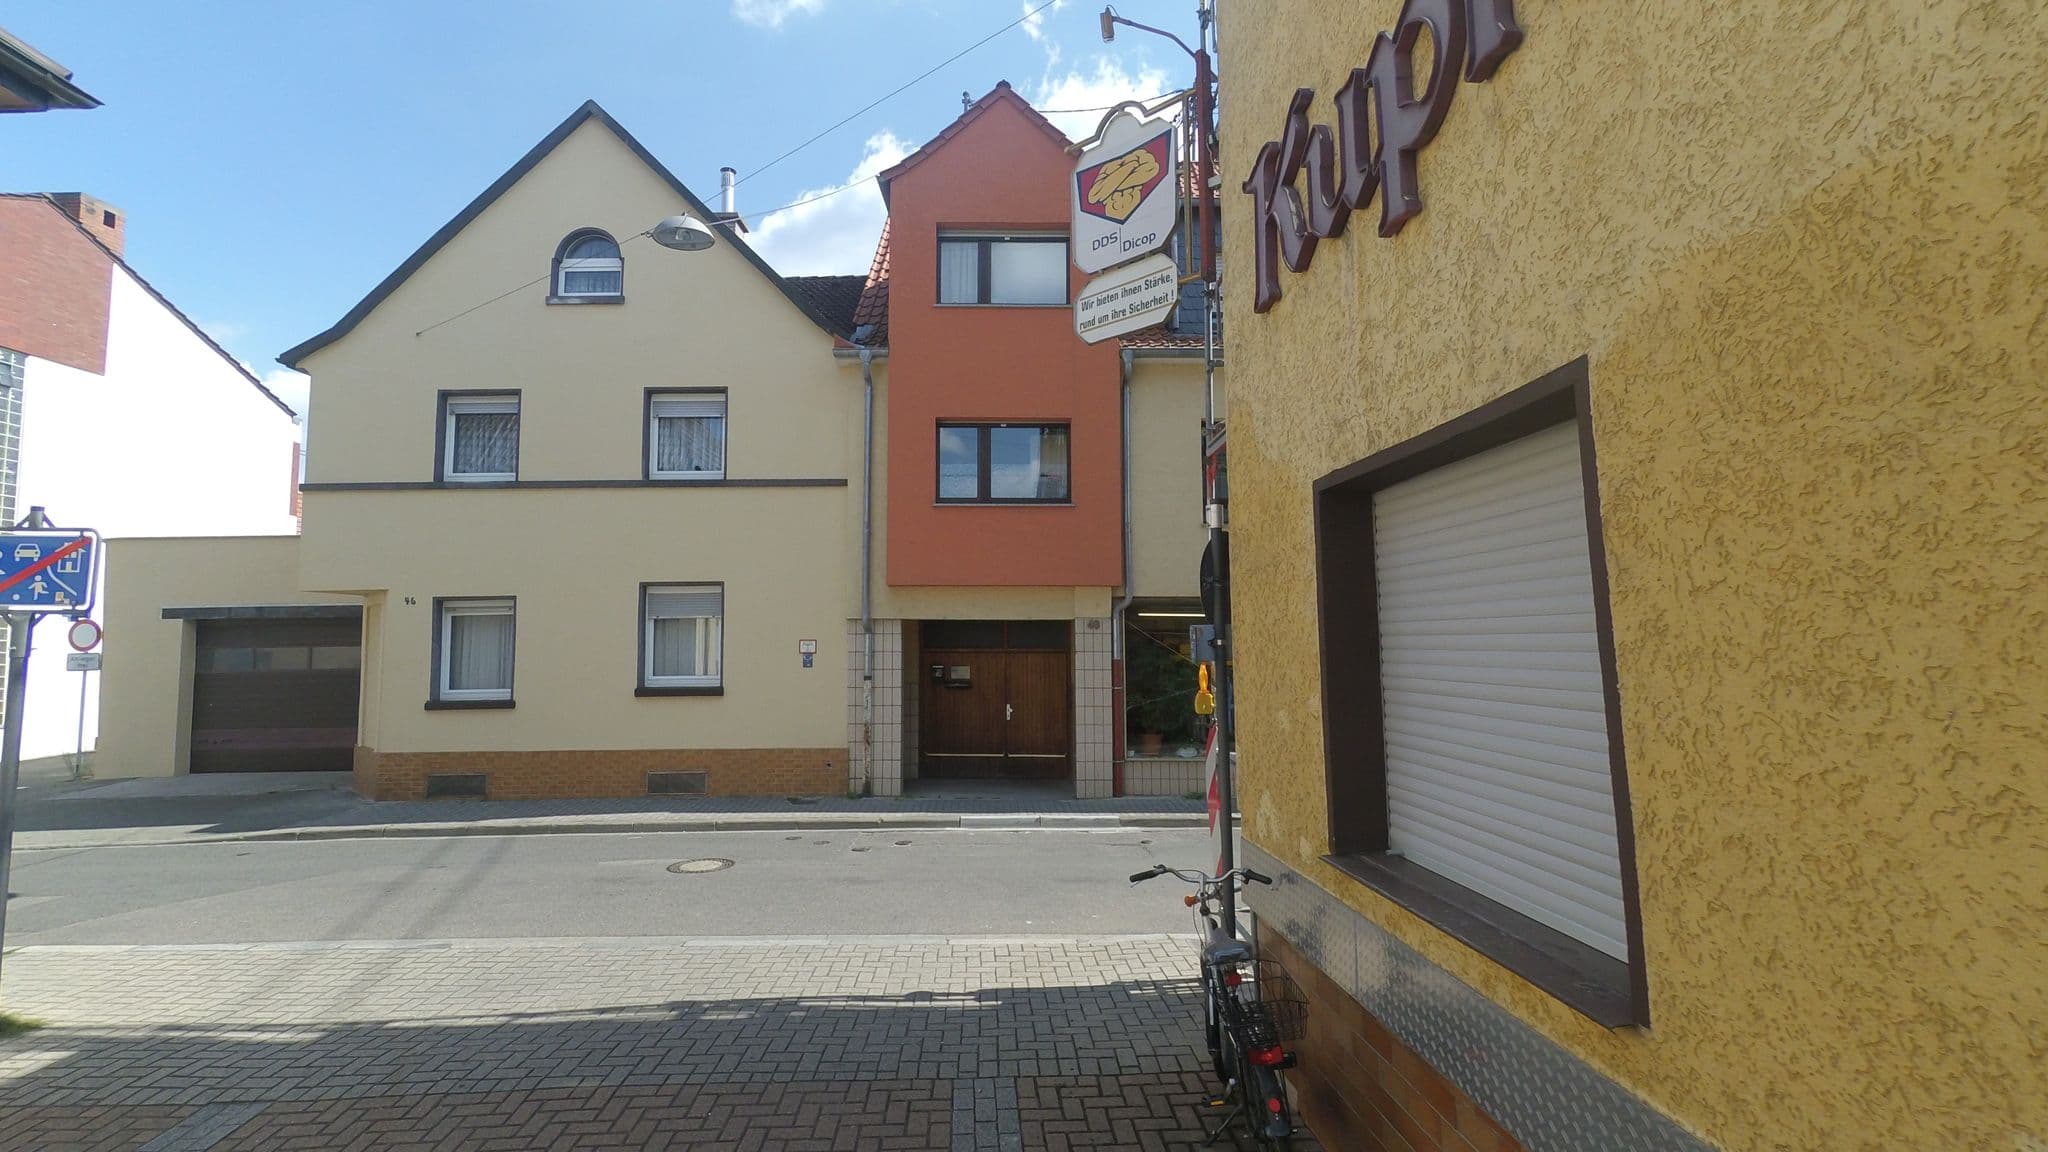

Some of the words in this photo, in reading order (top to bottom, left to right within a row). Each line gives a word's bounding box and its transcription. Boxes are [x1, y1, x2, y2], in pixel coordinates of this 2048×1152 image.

[1092, 231, 1118, 251] DDS
[1123, 232, 1157, 252] Dicop
[1081, 299, 1094, 312] Wir
[1096, 290, 1119, 307] bieten
[1121, 285, 1142, 299] ihnen
[1144, 273, 1173, 291] Stärke,
[1079, 315, 1096, 331] rund
[1097, 314, 1109, 324] um
[1111, 308, 1127, 320] ihre
[1129, 291, 1169, 315] Sicherheit
[404, 596, 417, 606] 46
